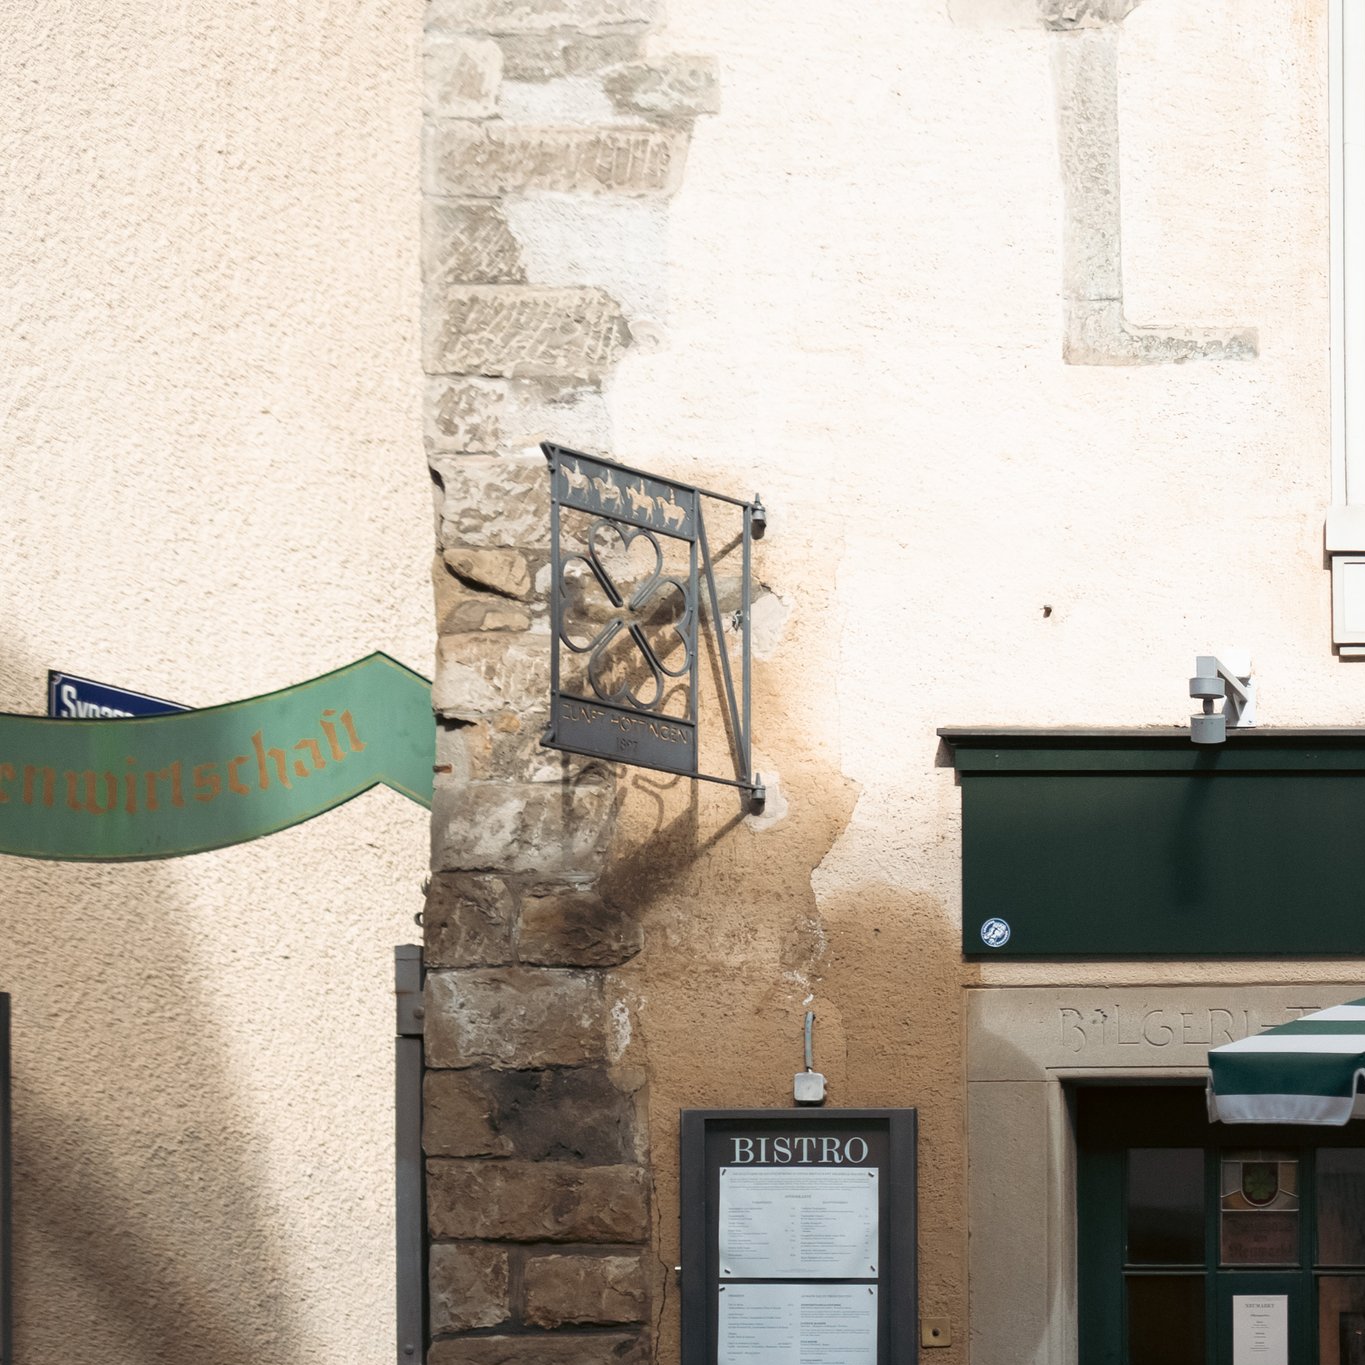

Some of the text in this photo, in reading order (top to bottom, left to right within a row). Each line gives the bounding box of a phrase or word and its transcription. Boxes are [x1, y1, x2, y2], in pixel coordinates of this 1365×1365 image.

[61, 684, 135, 718] Syn
[562, 702, 606, 724] ZUNFT
[730, 1136, 870, 1165] BISTRO
